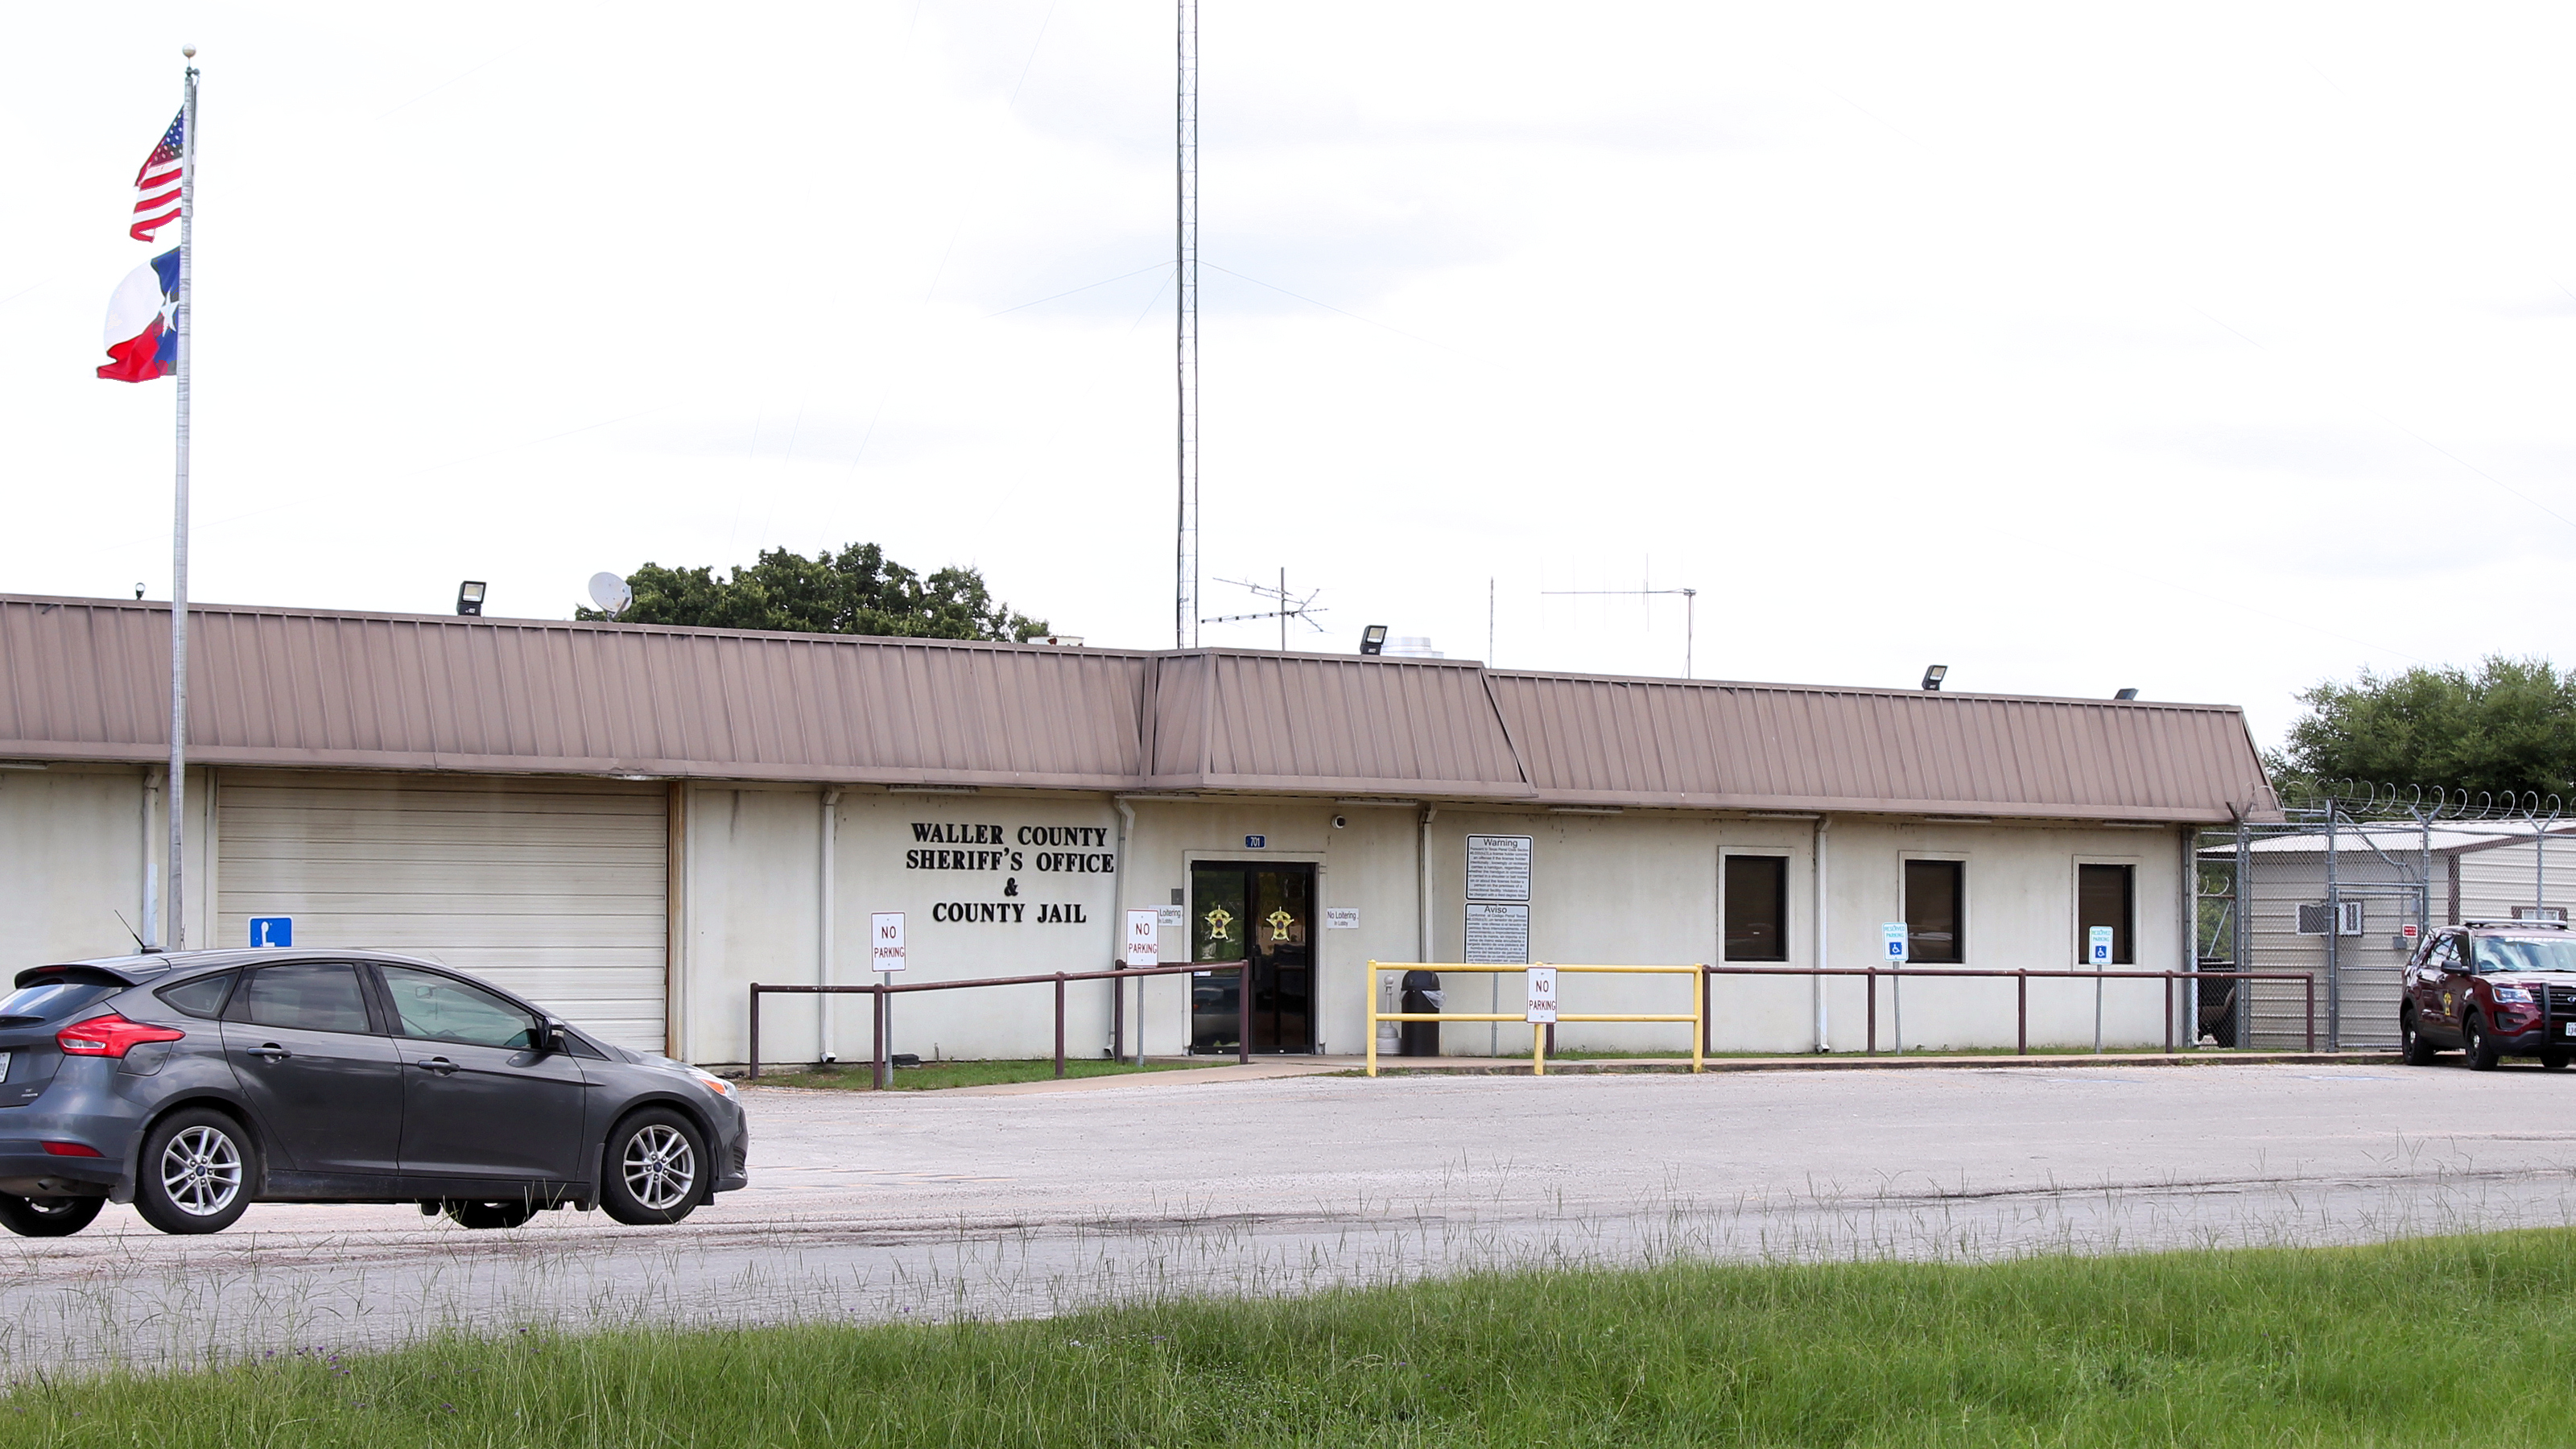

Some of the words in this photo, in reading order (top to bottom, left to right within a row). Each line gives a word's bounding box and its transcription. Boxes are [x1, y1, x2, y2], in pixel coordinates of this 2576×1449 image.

[910, 823, 1004, 844] WALLER
[1017, 826, 1108, 847] COUNTY
[1250, 836, 1260, 847] 701
[1484, 838, 1518, 848] Warning
[906, 847, 1023, 871] SHERIFF'S
[1036, 852, 1114, 873] OFFICE
[1004, 877, 1019, 897] &
[932, 902, 1026, 923] COUNTY
[1037, 903, 1087, 923] JAIL
[1159, 909, 1181, 919] Loitering
[1484, 905, 1507, 914] Aviso
[1335, 911, 1356, 921] Loitering
[881, 926, 896, 939] NO
[1136, 923, 1150, 935] NO
[874, 947, 905, 958] PARKING
[1129, 943, 1158, 954] PARKING
[1535, 980, 1550, 993] NO
[1529, 1000, 1556, 1011] PARKING
